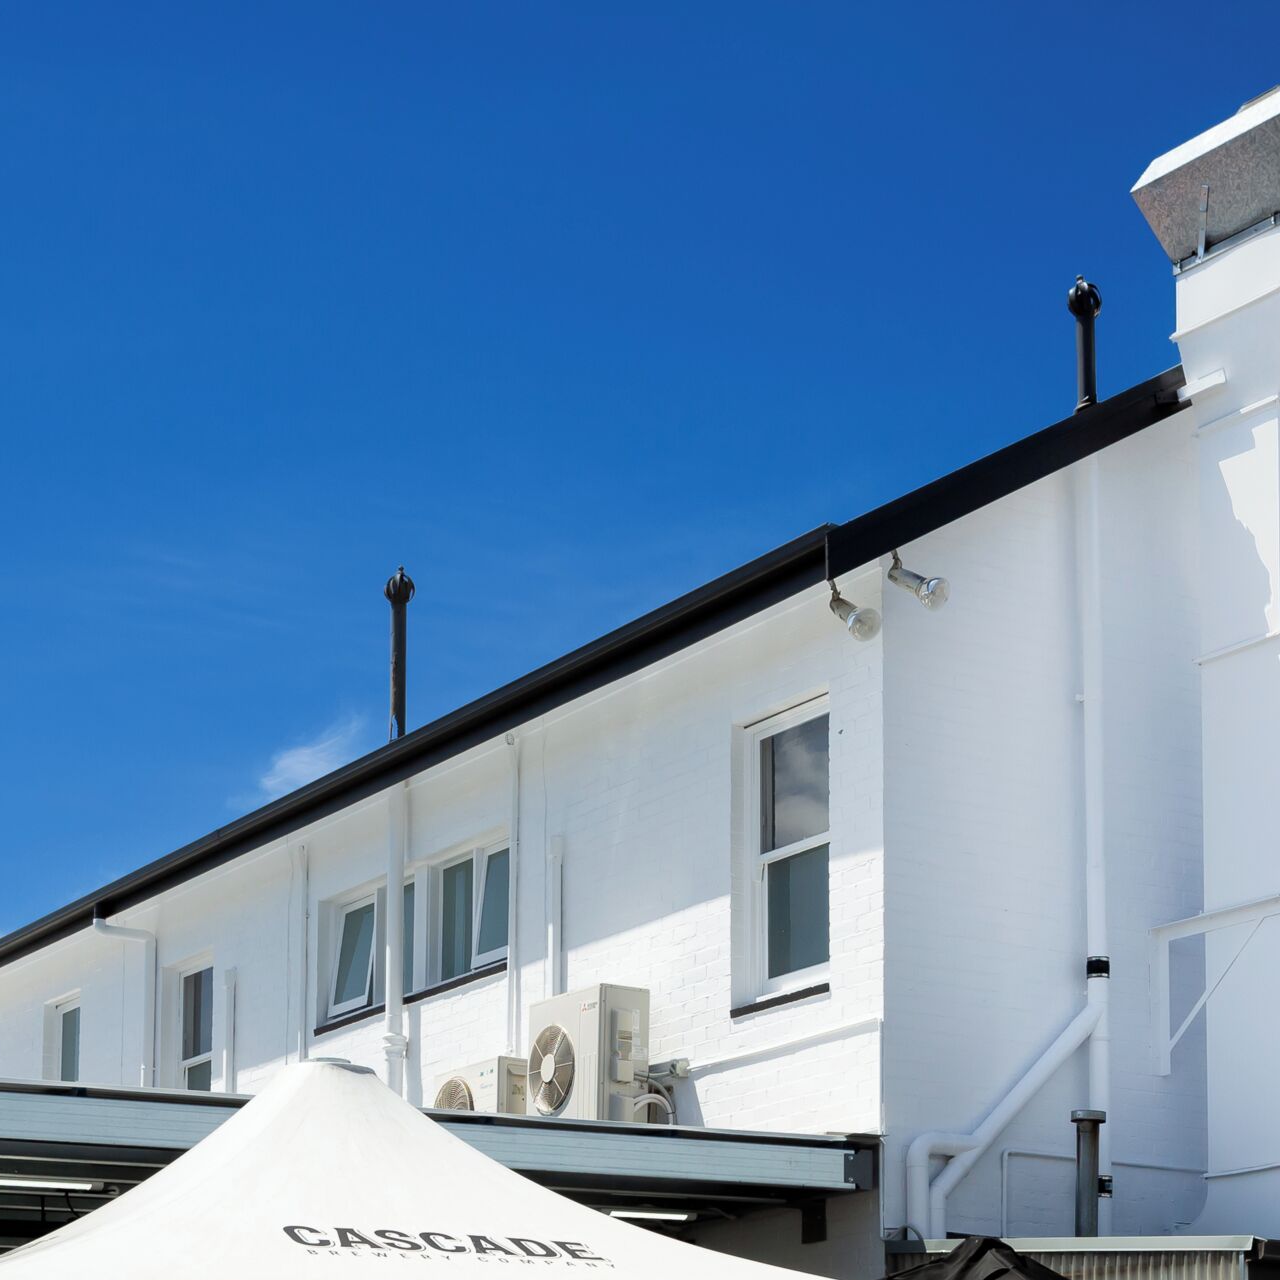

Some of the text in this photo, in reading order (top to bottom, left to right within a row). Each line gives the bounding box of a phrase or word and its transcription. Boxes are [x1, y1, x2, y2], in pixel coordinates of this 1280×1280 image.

[282, 1225, 609, 1261] CASCADE
[306, 1249, 616, 1269] BREWERY COMPANY
